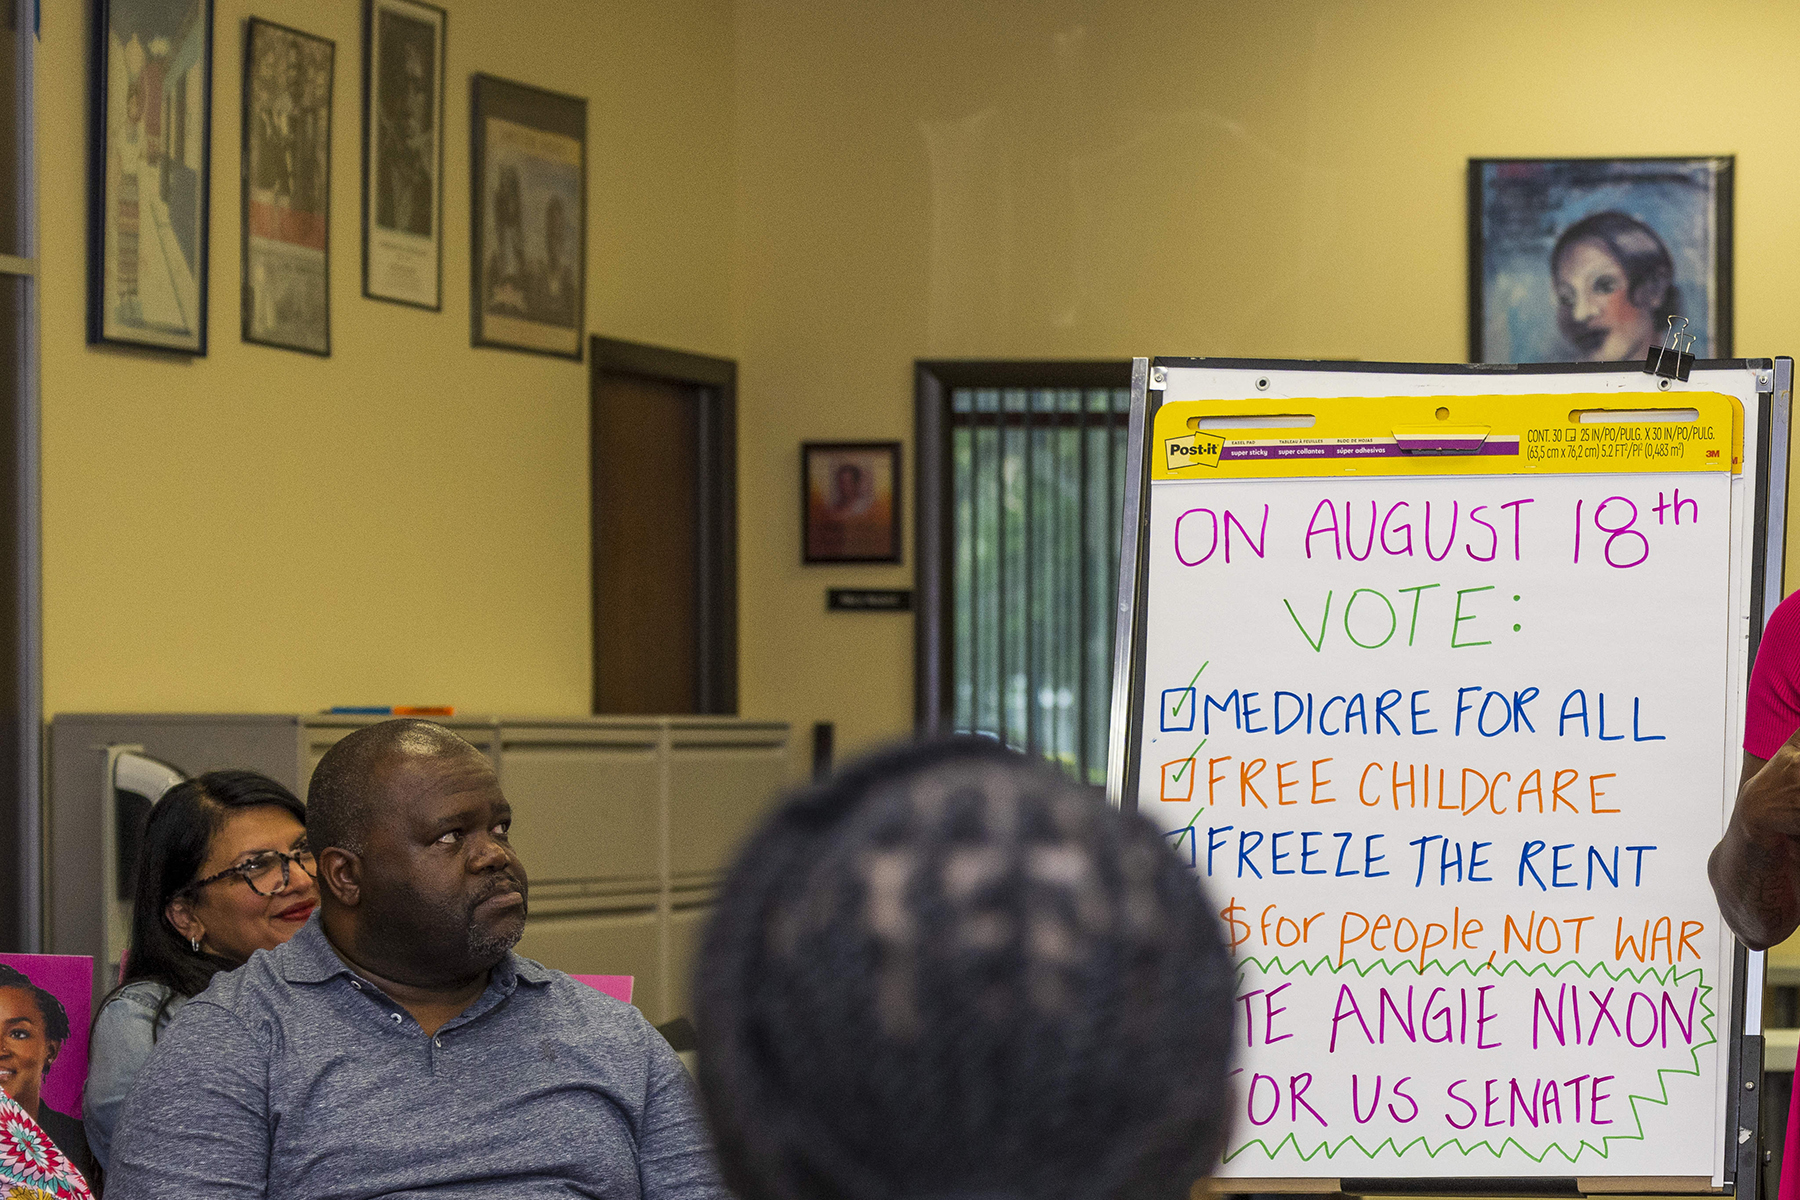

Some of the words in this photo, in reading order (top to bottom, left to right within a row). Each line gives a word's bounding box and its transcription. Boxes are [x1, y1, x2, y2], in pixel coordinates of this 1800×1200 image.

[1249, 448, 1268, 457] sticky
[1278, 448, 1296, 456] super
[1296, 447, 1325, 455] collantes
[1354, 445, 1386, 454] adhesivas
[1527, 429, 1551, 443] CONT.
[1552, 428, 1563, 442] 30
[1580, 428, 1590, 442] 25
[1591, 426, 1643, 443] IN/PO/PULG.
[1652, 427, 1662, 440] 30
[1663, 425, 1716, 442] IN/PO/PULG.
[1546, 448, 1559, 459] cm
[1567, 444, 1584, 460] 76,2
[1584, 443, 1600, 460] cm)
[1601, 444, 1614, 458] 5.2
[1644, 442, 1669, 460] (0,483
[1705, 450, 1720, 458] 3M
[1174, 502, 1270, 568] ON
[1305, 497, 1535, 564] AUGUST
[1573, 487, 1698, 569] 18th
[1283, 582, 1521, 653] VOTE:
[1202, 688, 1439, 738] MEDICARE
[1455, 685, 1541, 738] FOR
[1558, 687, 1667, 742] ALL
[1207, 755, 1337, 809] FREE
[1358, 760, 1621, 817] CHILDCARE
[1207, 825, 1391, 881] FREEZE
[1409, 833, 1494, 888] THE
[1518, 838, 1658, 893] RENT
[1502, 910, 1596, 956] NOT
[1613, 915, 1706, 968] WAR
[1328, 982, 1503, 1054] ANGIE
[1531, 982, 1700, 1051] NIXON
[1228, 1067, 1330, 1128] OR
[1350, 1073, 1420, 1126] US
[1444, 1072, 1616, 1131] SENATE
